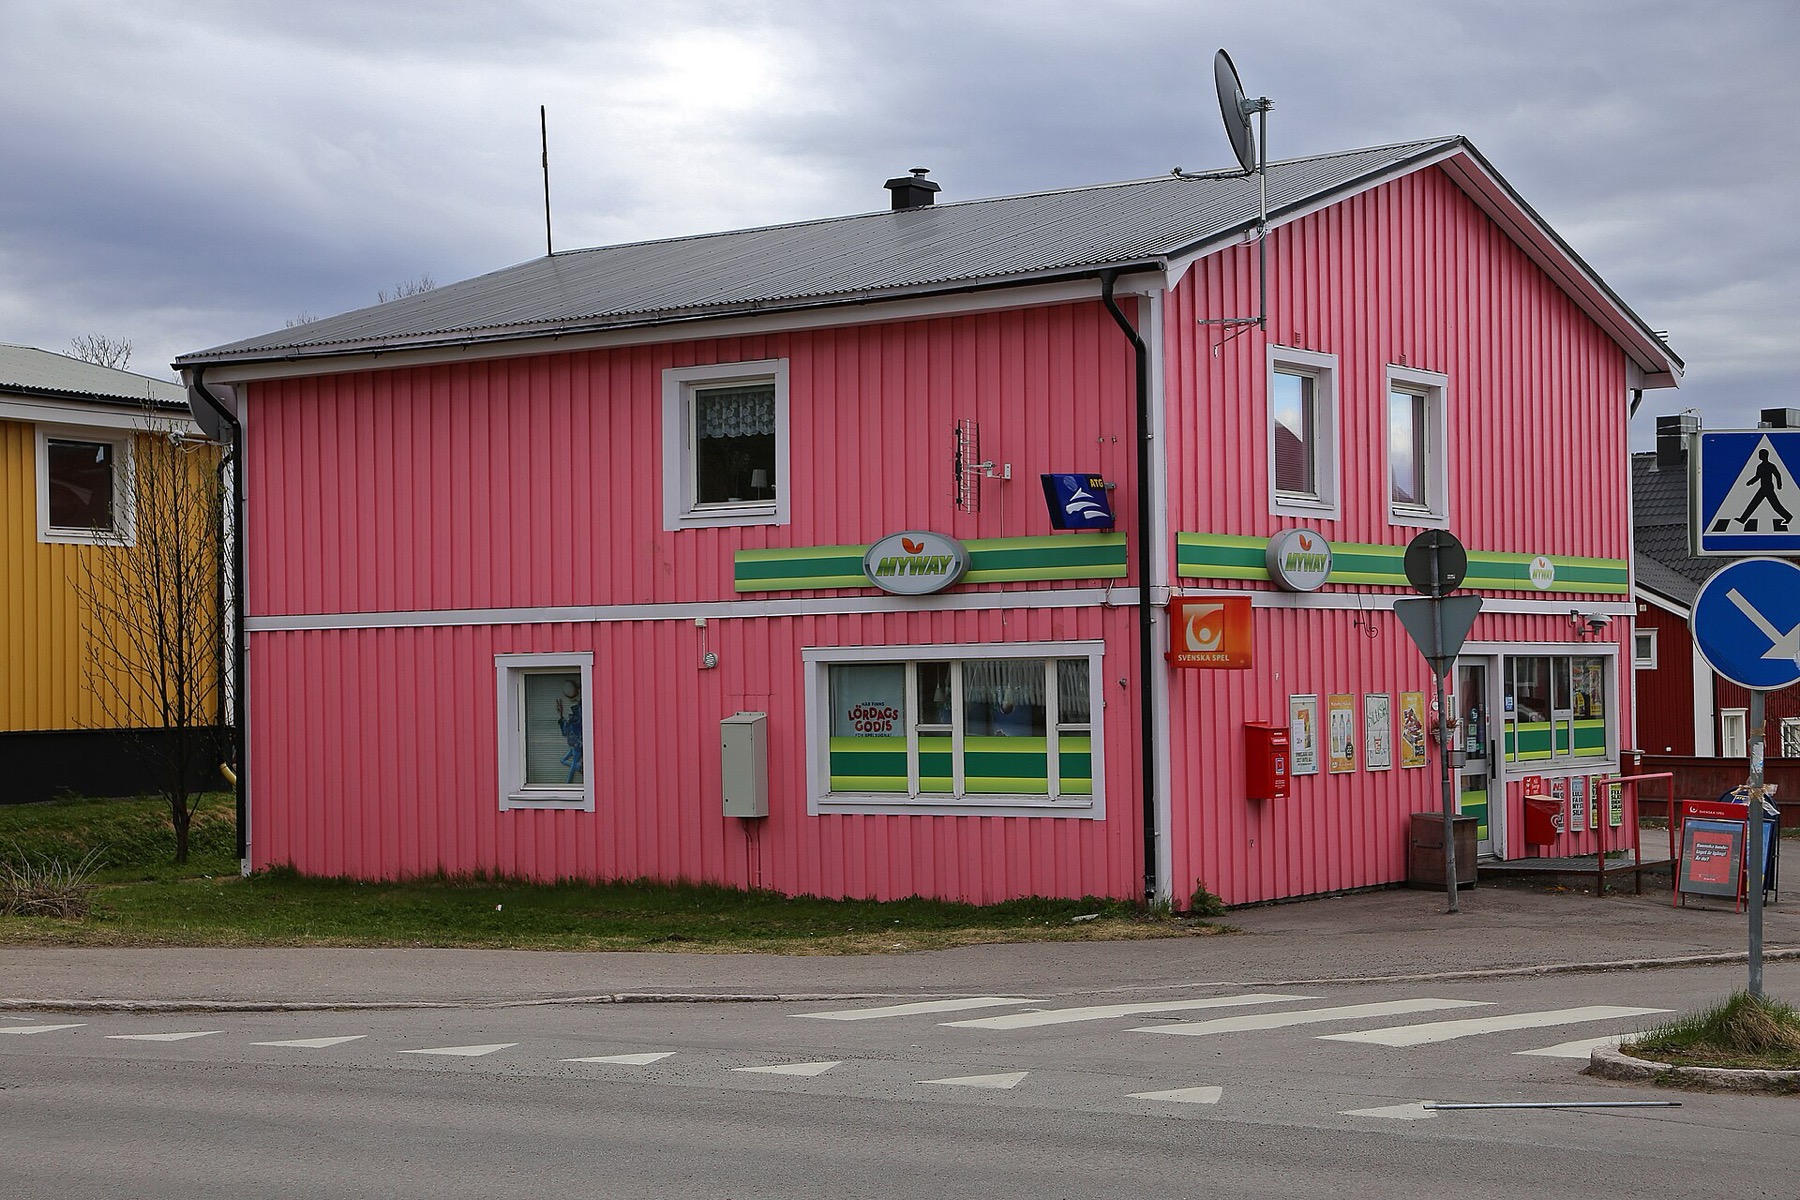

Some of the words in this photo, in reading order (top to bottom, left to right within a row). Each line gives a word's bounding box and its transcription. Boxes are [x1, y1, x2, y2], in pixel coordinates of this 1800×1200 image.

[1089, 478, 1104, 488] ATG
[875, 555, 954, 577] MYWAY
[1285, 552, 1328, 573] MYWAY
[1531, 569, 1553, 580] MYWAY
[1178, 654, 1210, 662] SVENSKA
[1212, 654, 1230, 662] SPEL
[848, 704, 898, 720] LÖRDAGS
[855, 720, 892, 732] GODIS
